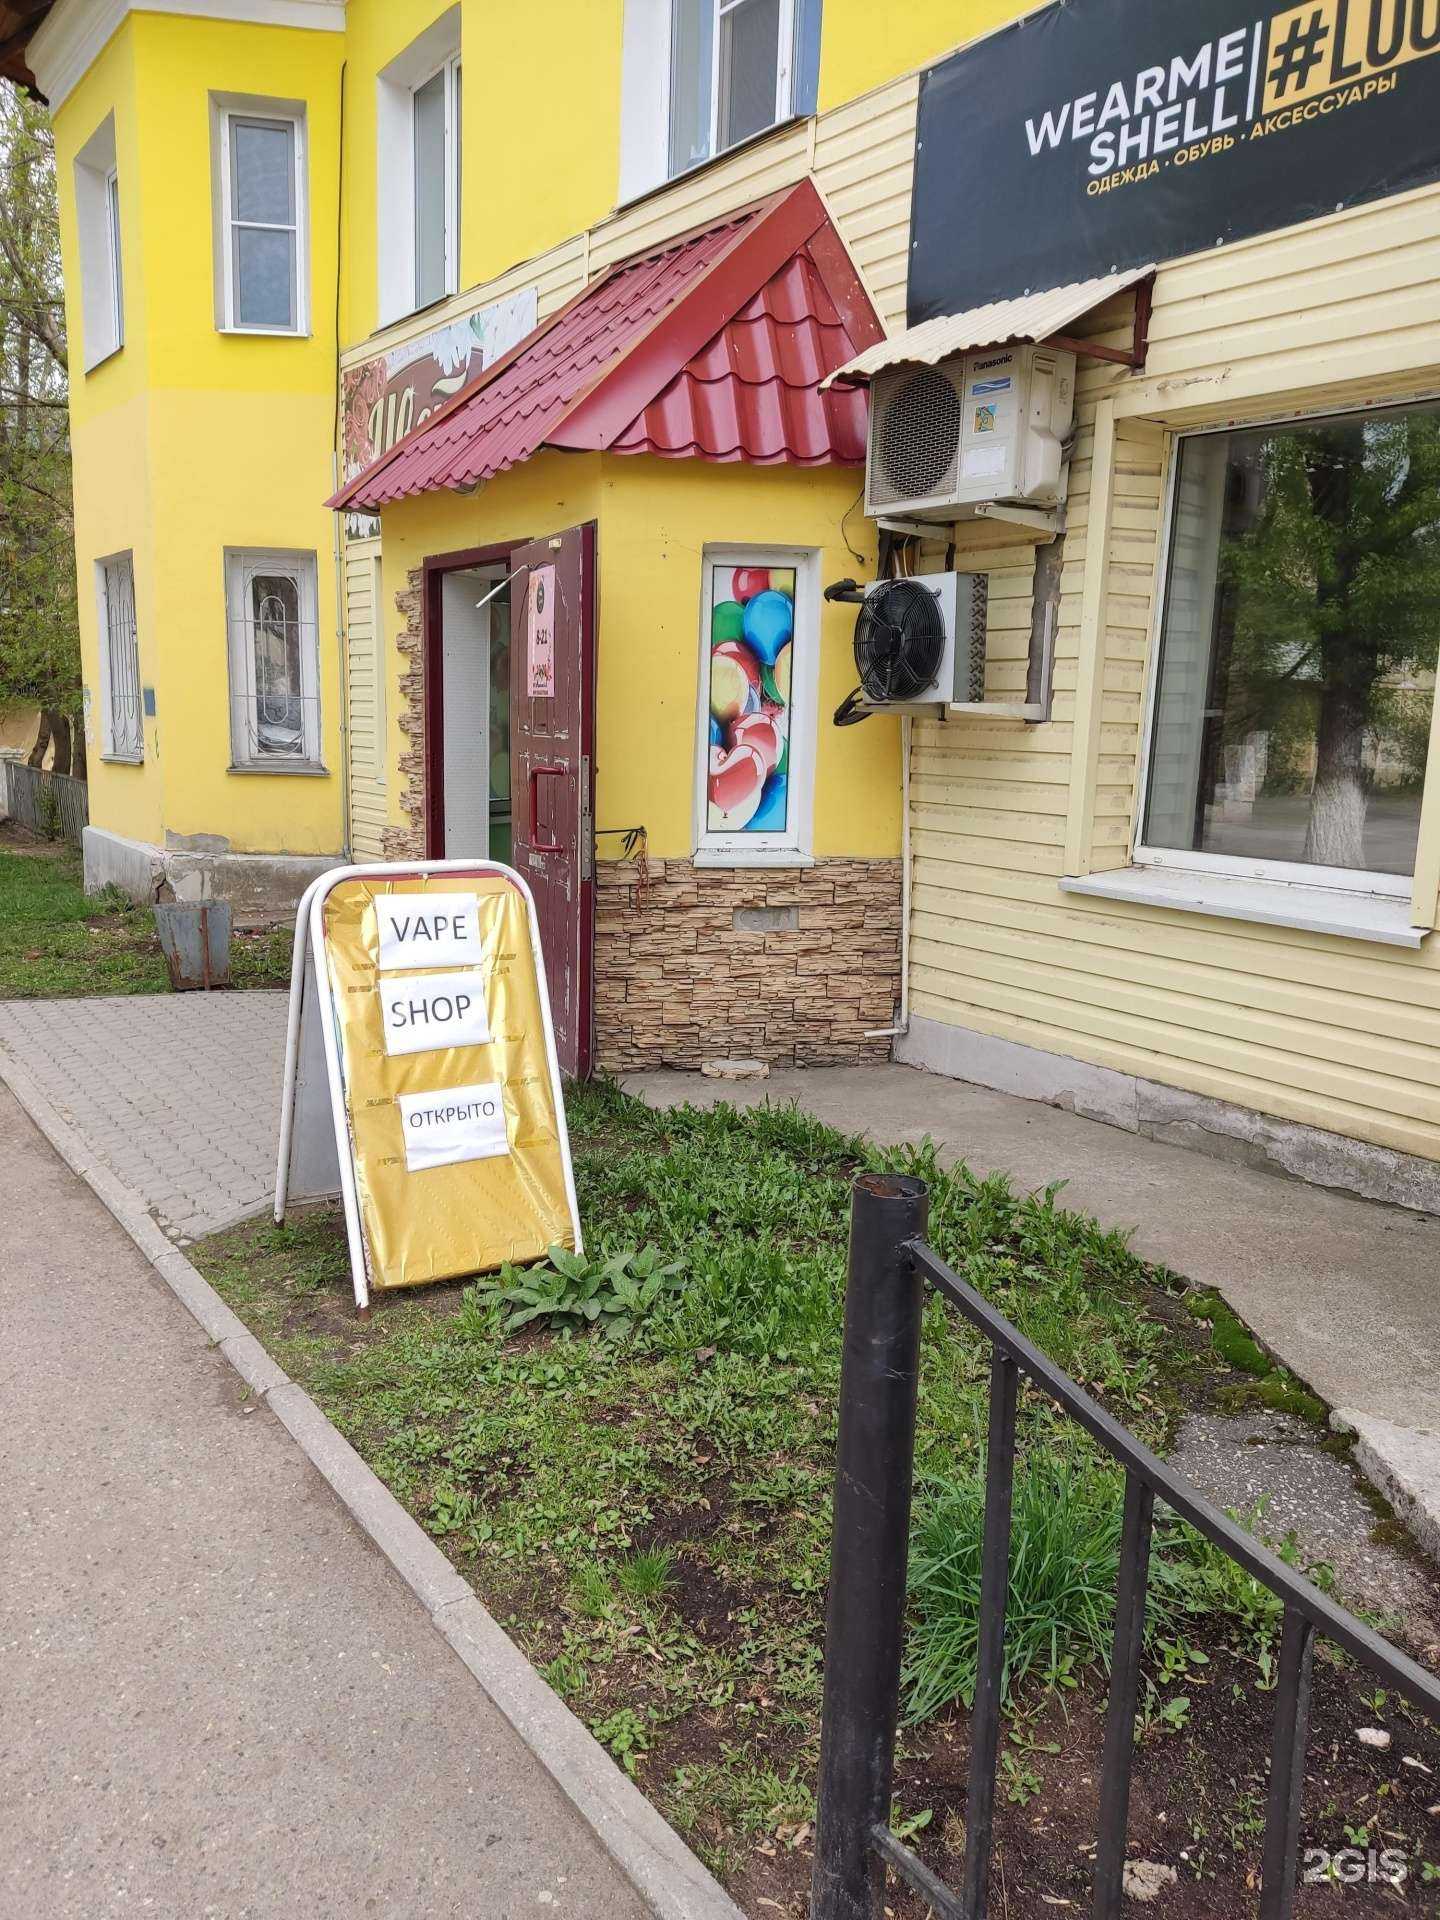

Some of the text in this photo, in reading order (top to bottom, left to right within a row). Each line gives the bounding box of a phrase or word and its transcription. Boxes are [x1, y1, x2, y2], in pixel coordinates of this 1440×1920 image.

[1024, 29, 1247, 156] WEARME
[1086, 72, 1398, 196] ОДЕЖДА ОБУВЬ АКСЕССУАРЫ
[1087, 86, 1240, 175] SHELL
[973, 353, 1013, 372] Panasonic
[390, 915, 468, 942] VAPE
[391, 995, 472, 1027] SHOP
[409, 1101, 496, 1128] ОТКРЫТО
